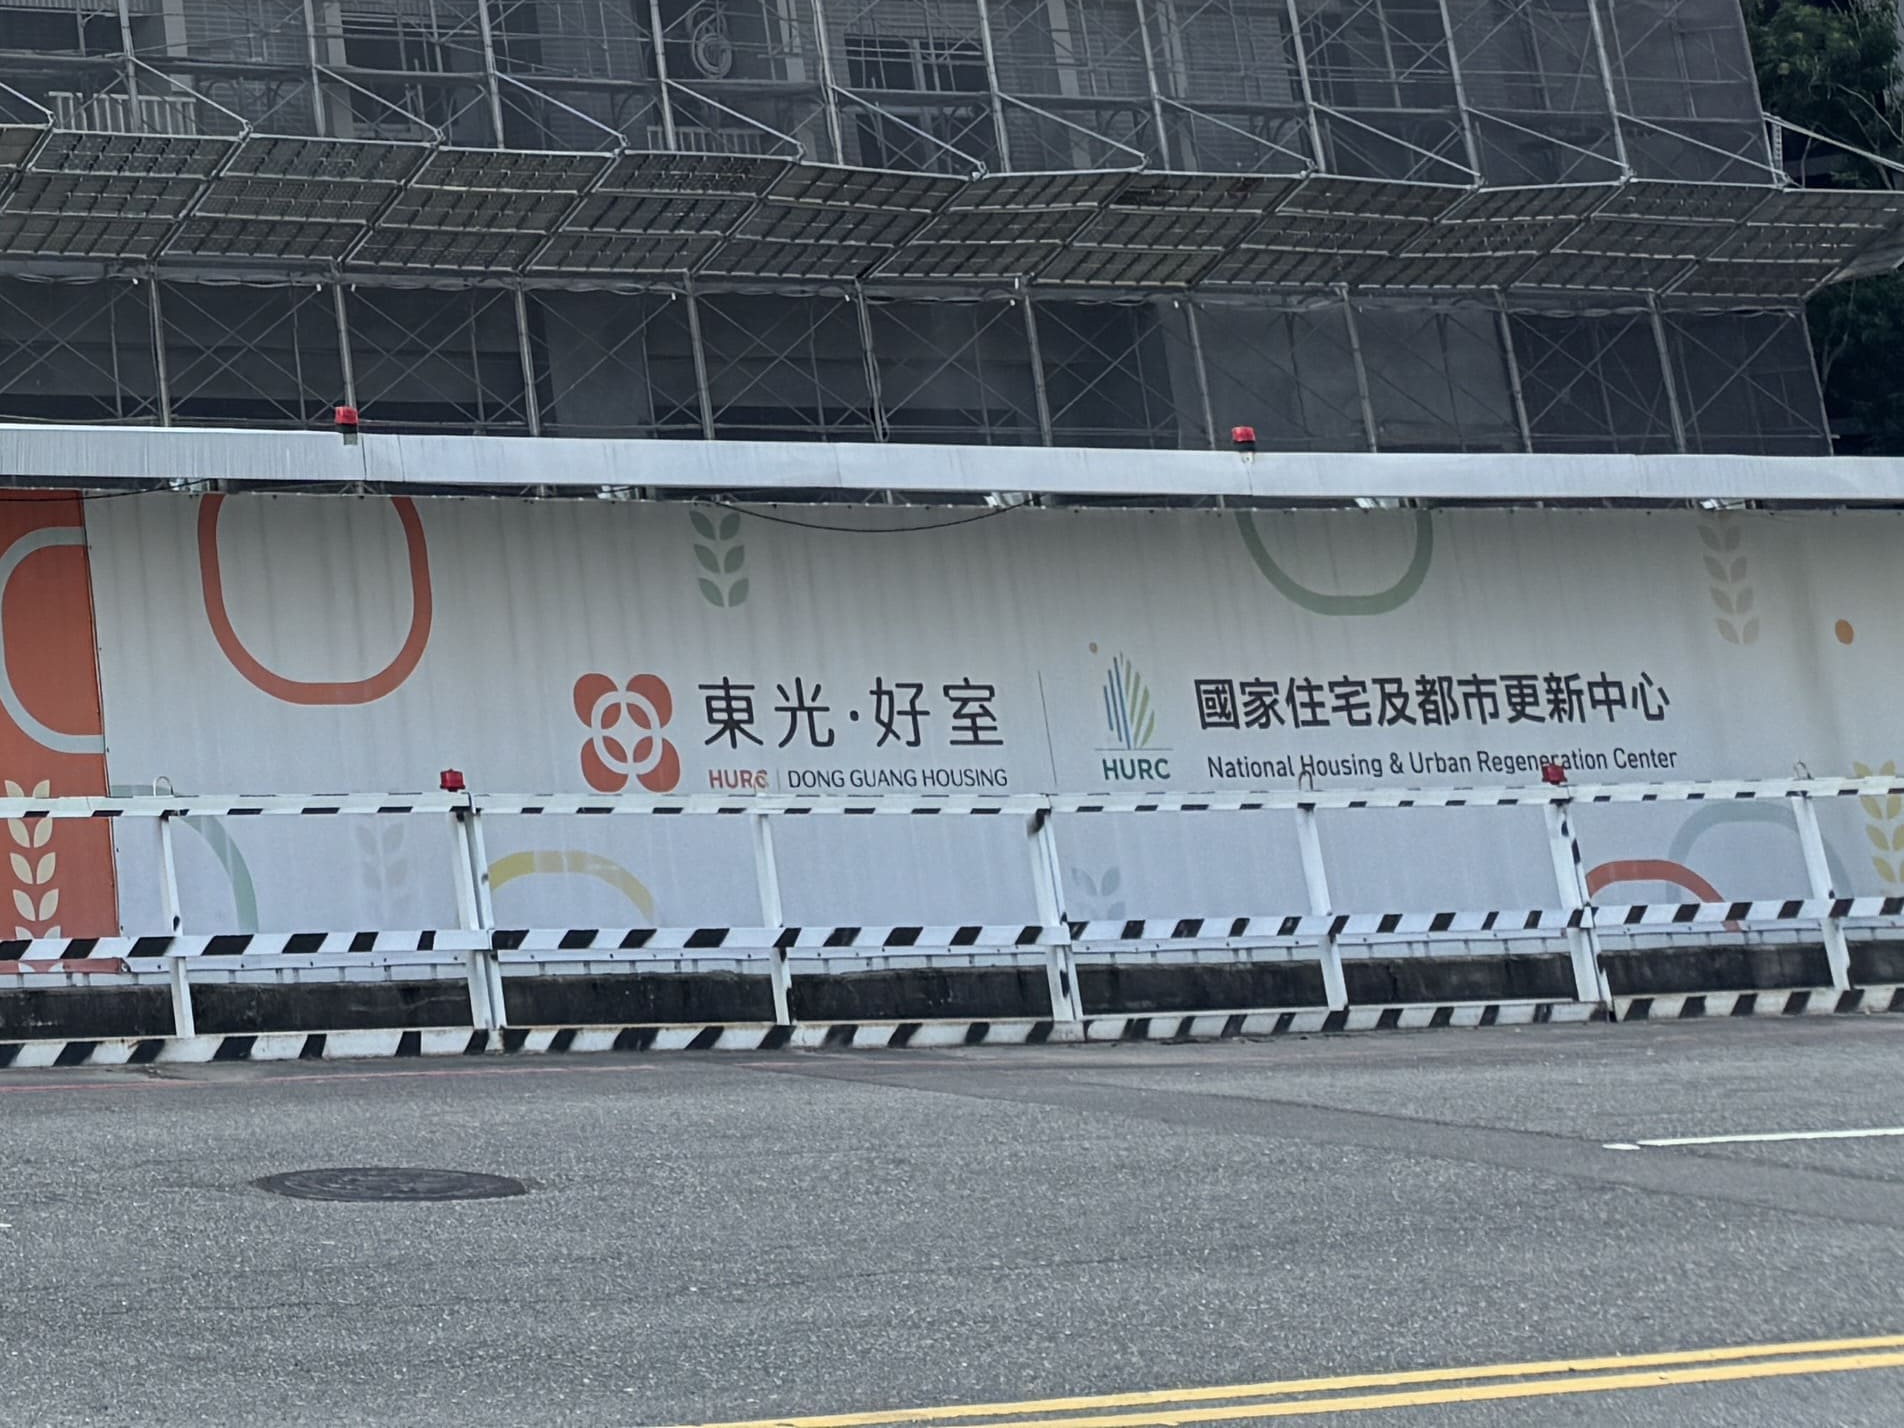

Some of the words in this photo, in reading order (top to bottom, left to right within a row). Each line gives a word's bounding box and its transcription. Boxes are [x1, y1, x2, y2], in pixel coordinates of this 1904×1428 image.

[1194, 670, 1671, 731] 國家住宅及都市更新中心
[1103, 758, 1171, 781] HURC
[1207, 754, 1294, 779] National
[1302, 753, 1384, 777] Housing
[1390, 752, 1405, 774] &
[1409, 750, 1471, 775] Urban
[1477, 748, 1608, 775] Regeneration
[1613, 747, 1678, 769] Center
[708, 768, 768, 789] HURC
[788, 768, 845, 789] DONG
[849, 768, 918, 789] GUANG
[923, 767, 1009, 788] HOUSING
